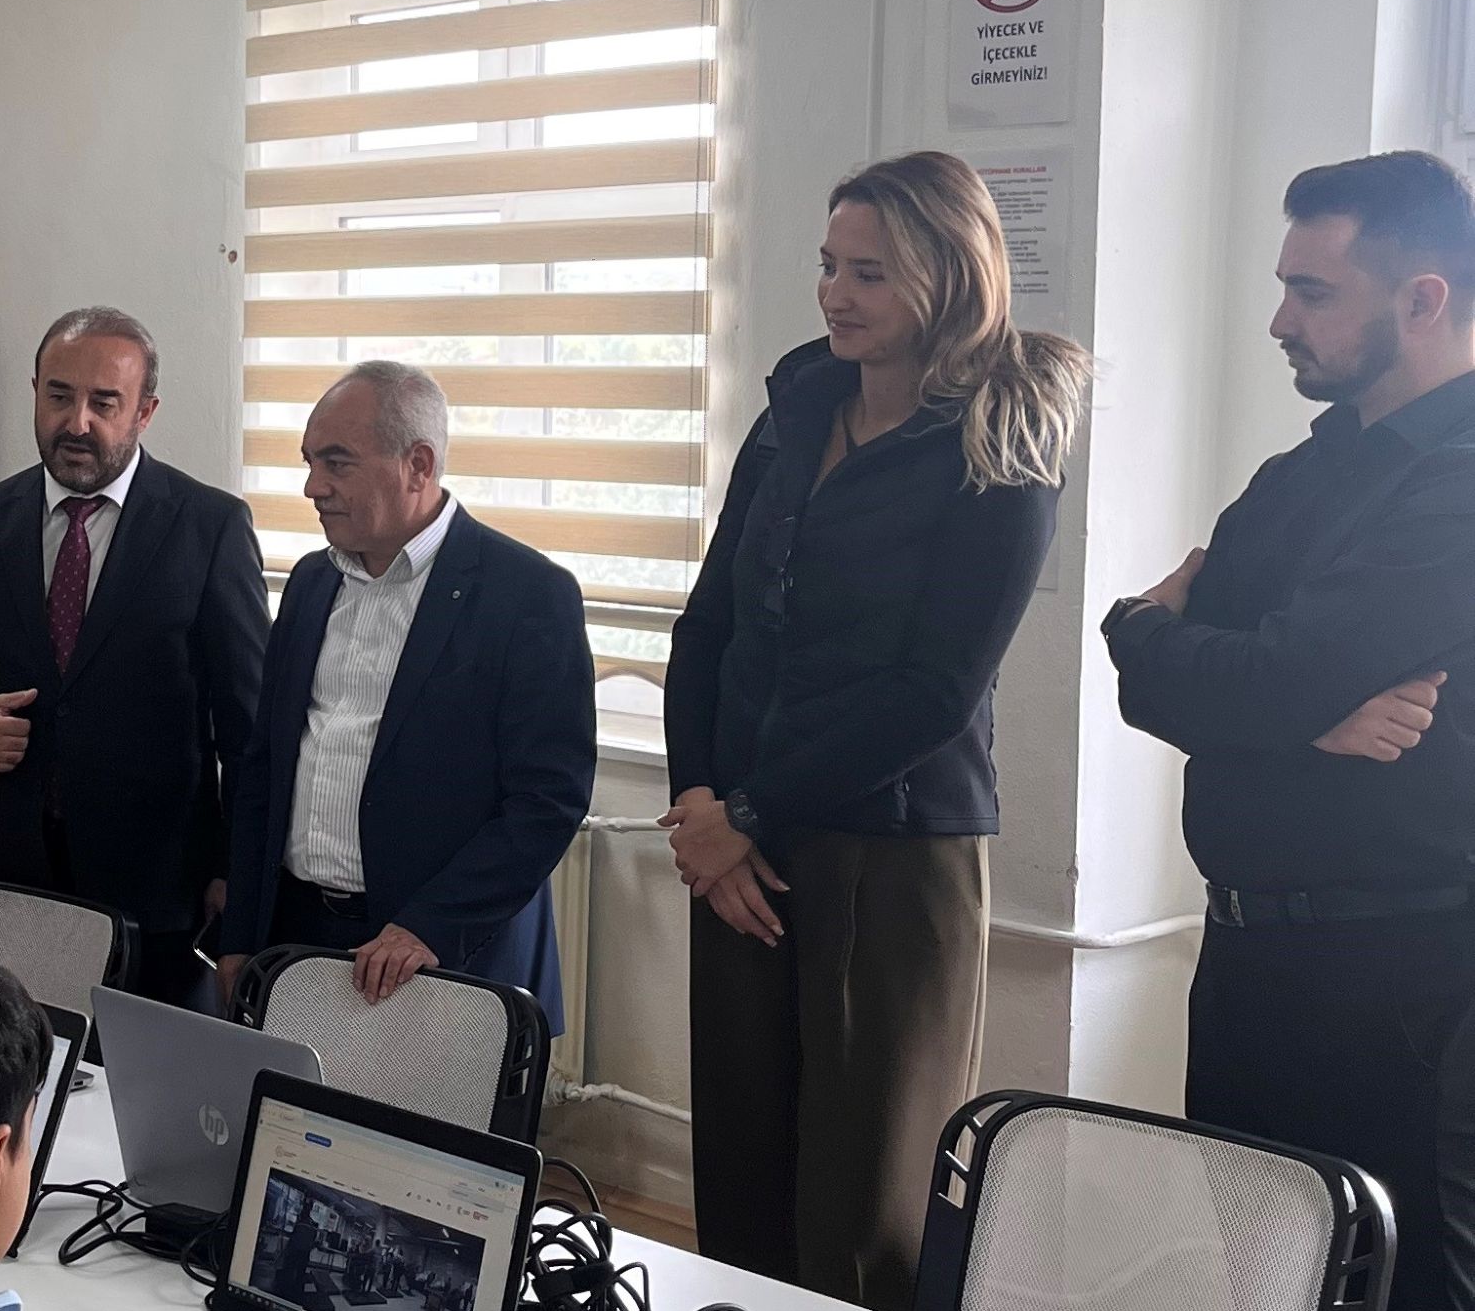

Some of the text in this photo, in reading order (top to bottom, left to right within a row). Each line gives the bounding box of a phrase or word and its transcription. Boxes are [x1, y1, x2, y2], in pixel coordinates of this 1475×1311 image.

[977, 20, 1044, 39] YİYECEK VE
[983, 45, 1037, 64] İÇECEKLE
[971, 65, 1047, 85] GİRMEYİNİZ!
[202, 1104, 226, 1145] hp
